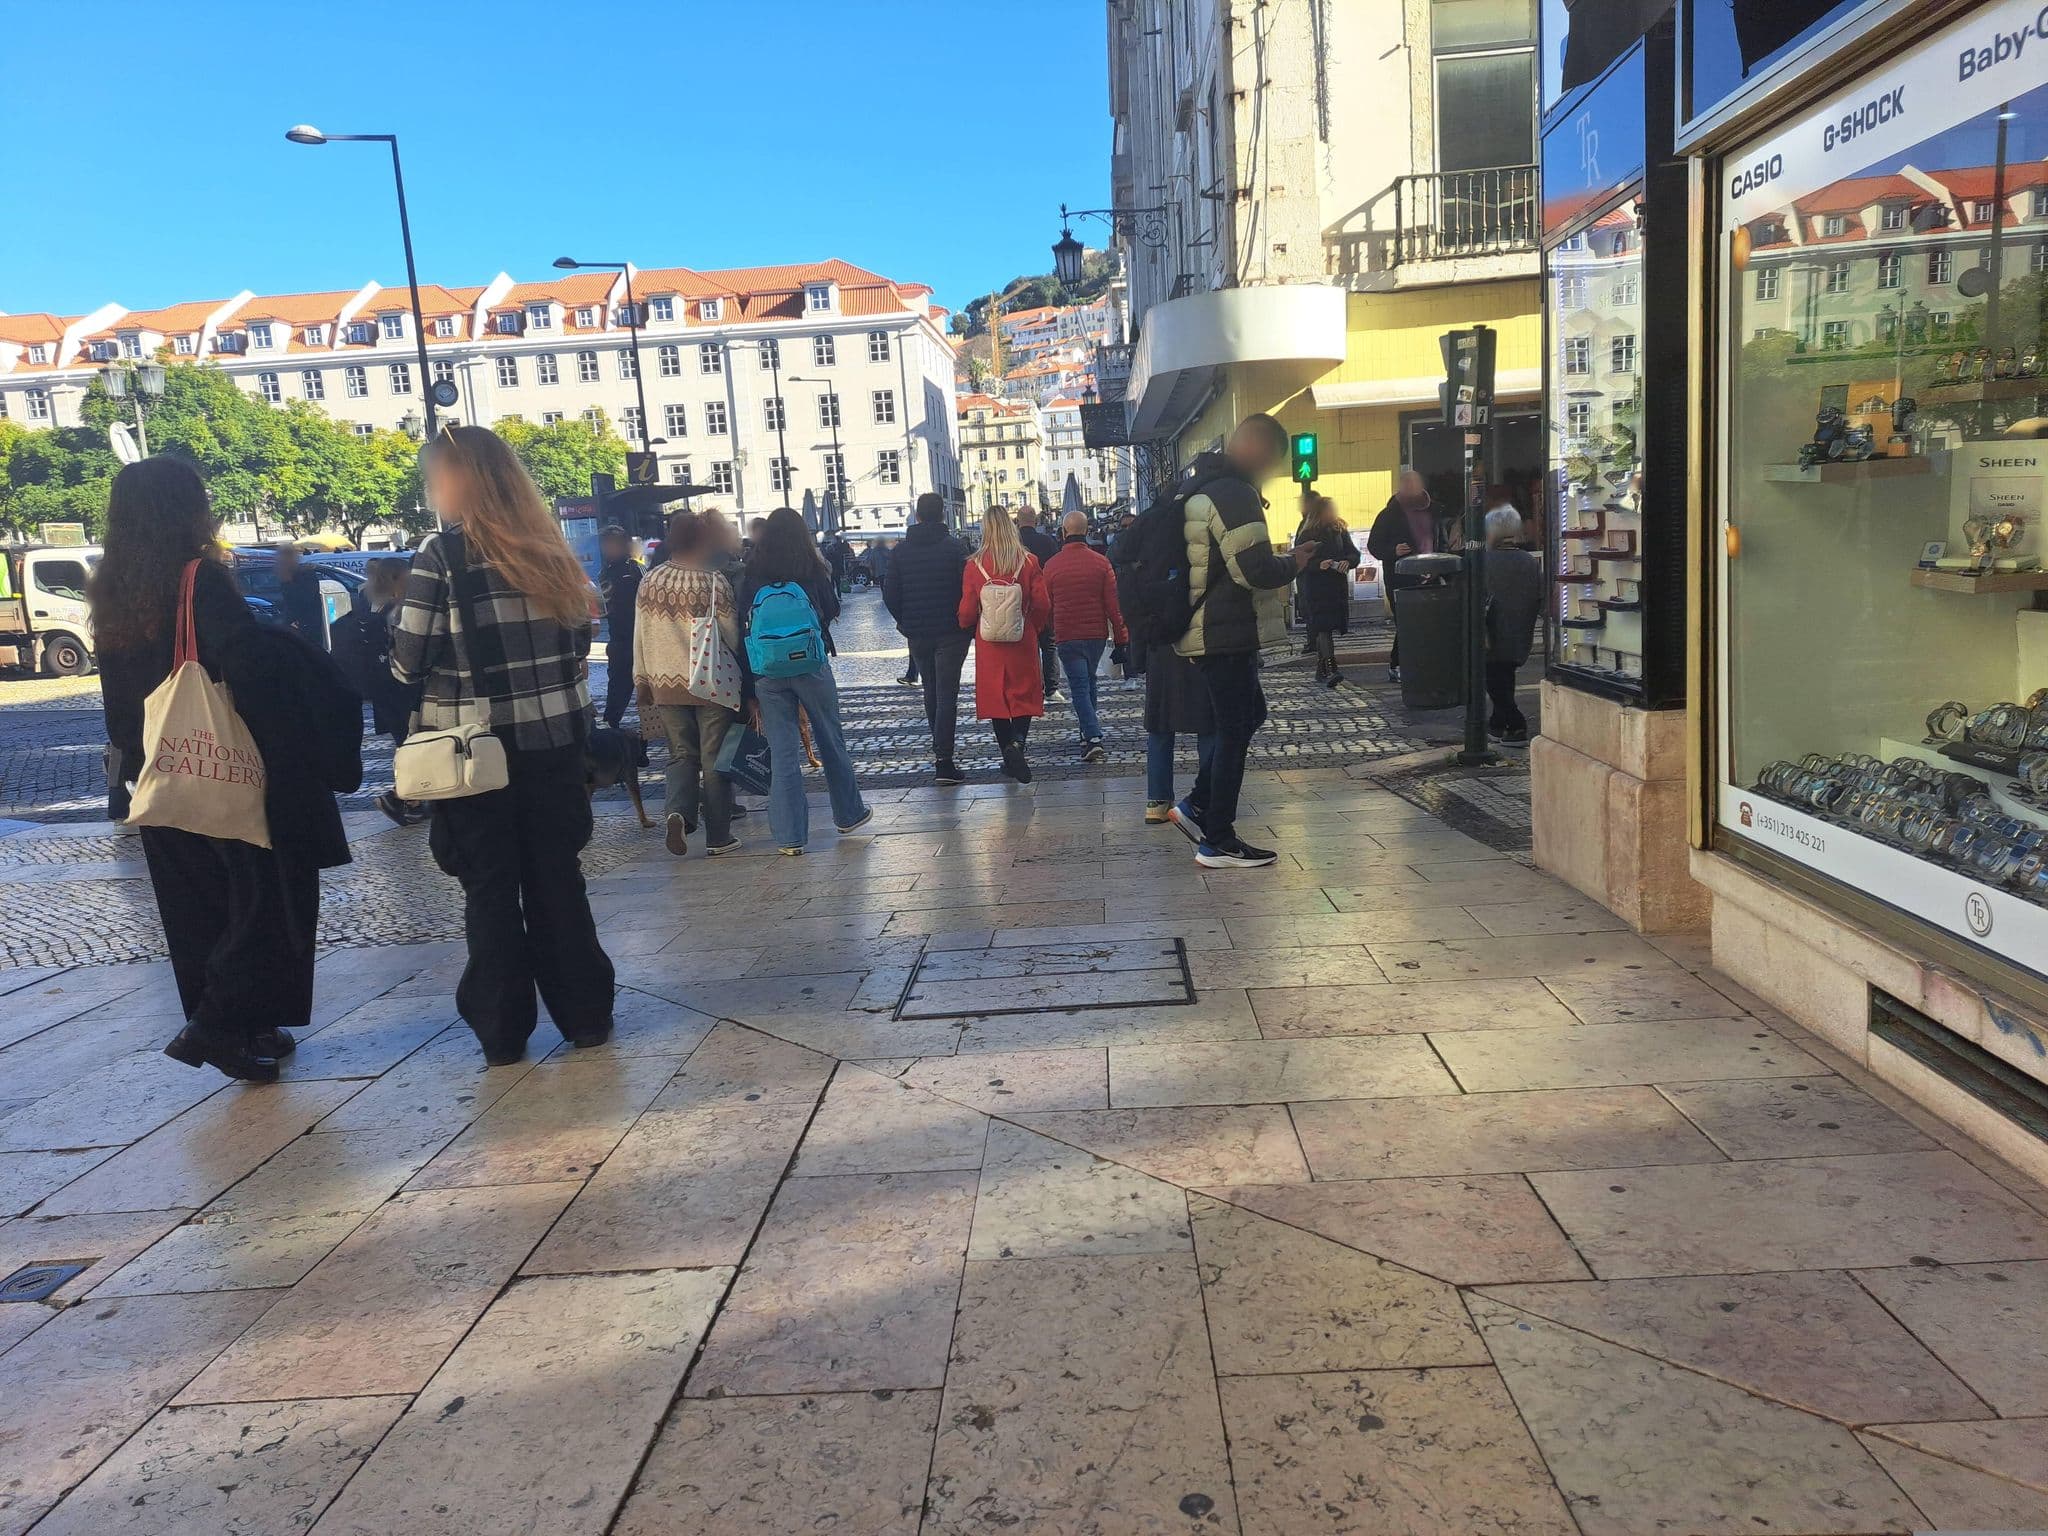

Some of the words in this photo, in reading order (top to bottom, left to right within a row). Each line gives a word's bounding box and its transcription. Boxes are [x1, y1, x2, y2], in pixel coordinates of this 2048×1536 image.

[1823, 84, 1906, 153] G-SHOCK
[1731, 153, 1783, 200] CASIO
[1979, 457, 2037, 468] SHEEN
[1988, 493, 2025, 501] SHEEN
[192, 728, 215, 742] THE
[160, 736, 265, 769] NATIONAL
[155, 755, 266, 789] GALLERY
[1756, 812, 1780, 835] (+351)
[1780, 823, 1795, 840] 213
[1795, 830, 1810, 847] 425
[1811, 835, 1826, 853] 221
